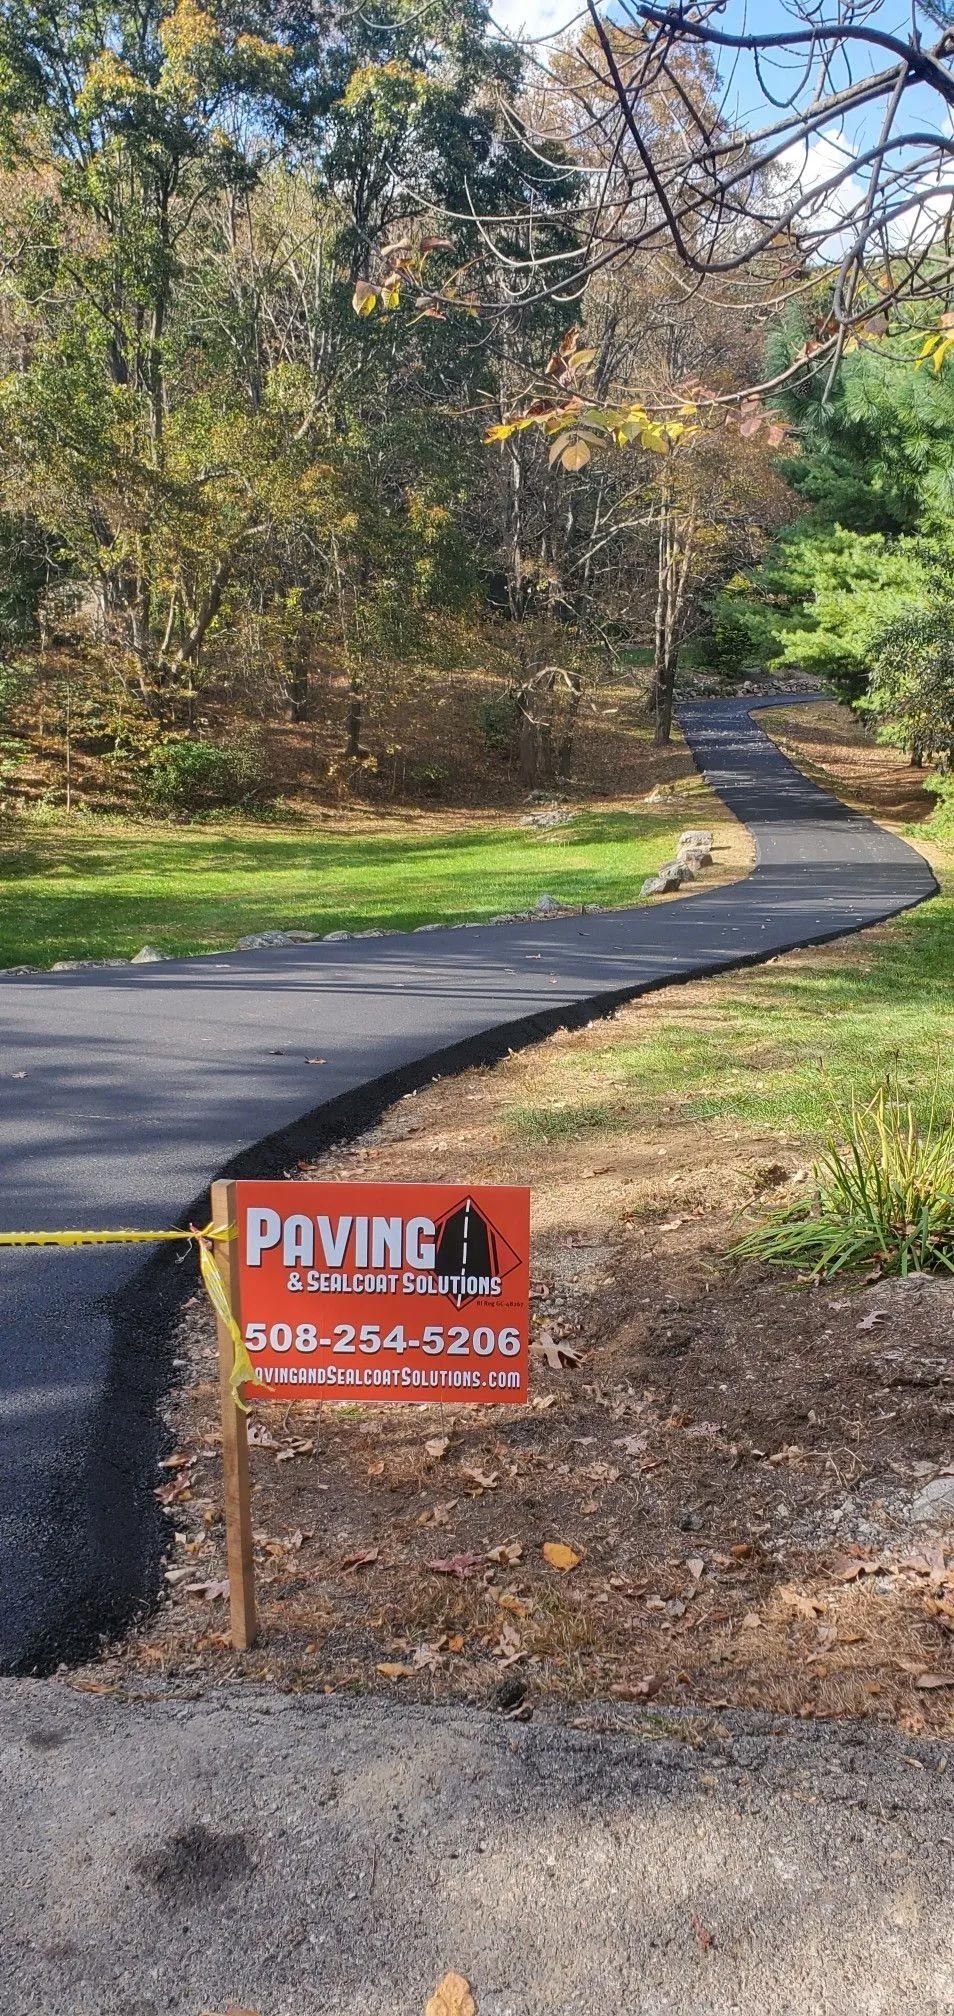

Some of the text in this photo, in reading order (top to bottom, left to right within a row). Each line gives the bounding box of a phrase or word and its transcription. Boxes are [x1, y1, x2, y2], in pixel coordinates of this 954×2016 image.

[246, 1207, 437, 1270] PAVING
[287, 1270, 502, 1296] & SEALCOAT SOLUTIONS
[245, 1323, 522, 1356] 508-254-5206
[253, 1365, 521, 1389] AVINGANDSEALCOATSOLUTIONS.COM
